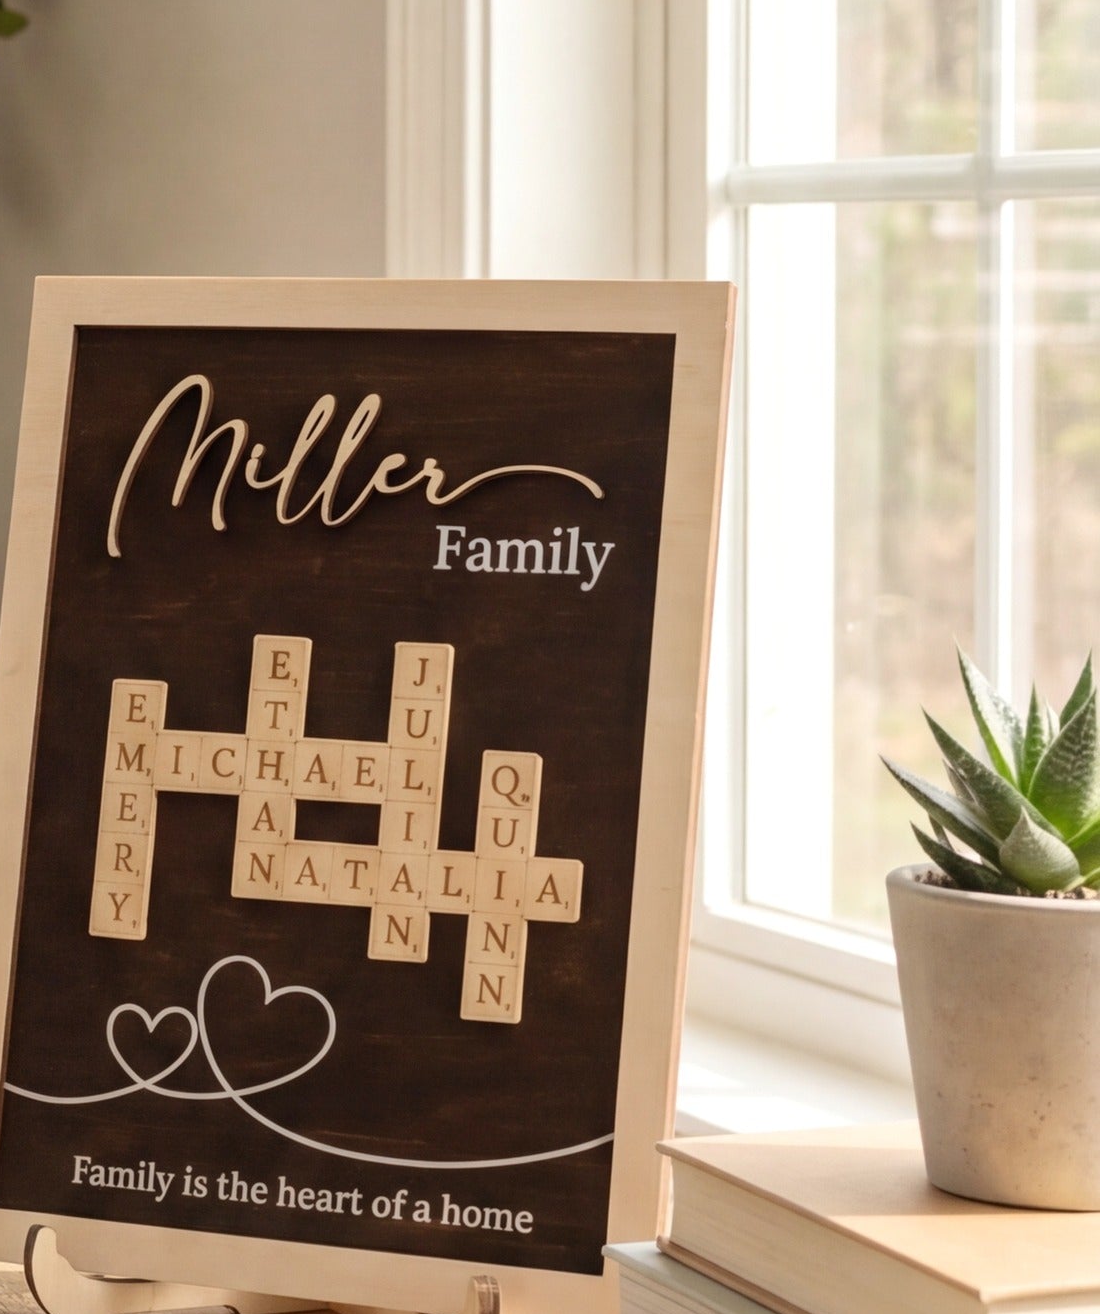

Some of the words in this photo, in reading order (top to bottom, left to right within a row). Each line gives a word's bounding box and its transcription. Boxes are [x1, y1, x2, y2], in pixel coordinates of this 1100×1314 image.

[107, 374, 606, 558] Miller
[433, 525, 616, 591] Family
[108, 692, 148, 923] EMERY
[114, 741, 424, 792] MICHAEL
[247, 649, 291, 884] ETHAN
[385, 656, 433, 947] JULIAN
[247, 851, 563, 906] NATALIA
[475, 764, 521, 1007] QUINN
[71, 1155, 175, 1202] Family
[181, 1165, 208, 1198] is
[216, 1171, 269, 1204] the
[277, 1176, 362, 1216] heart
[371, 1188, 411, 1221] of
[414, 1200, 432, 1223] a
[441, 1195, 534, 1234] home
